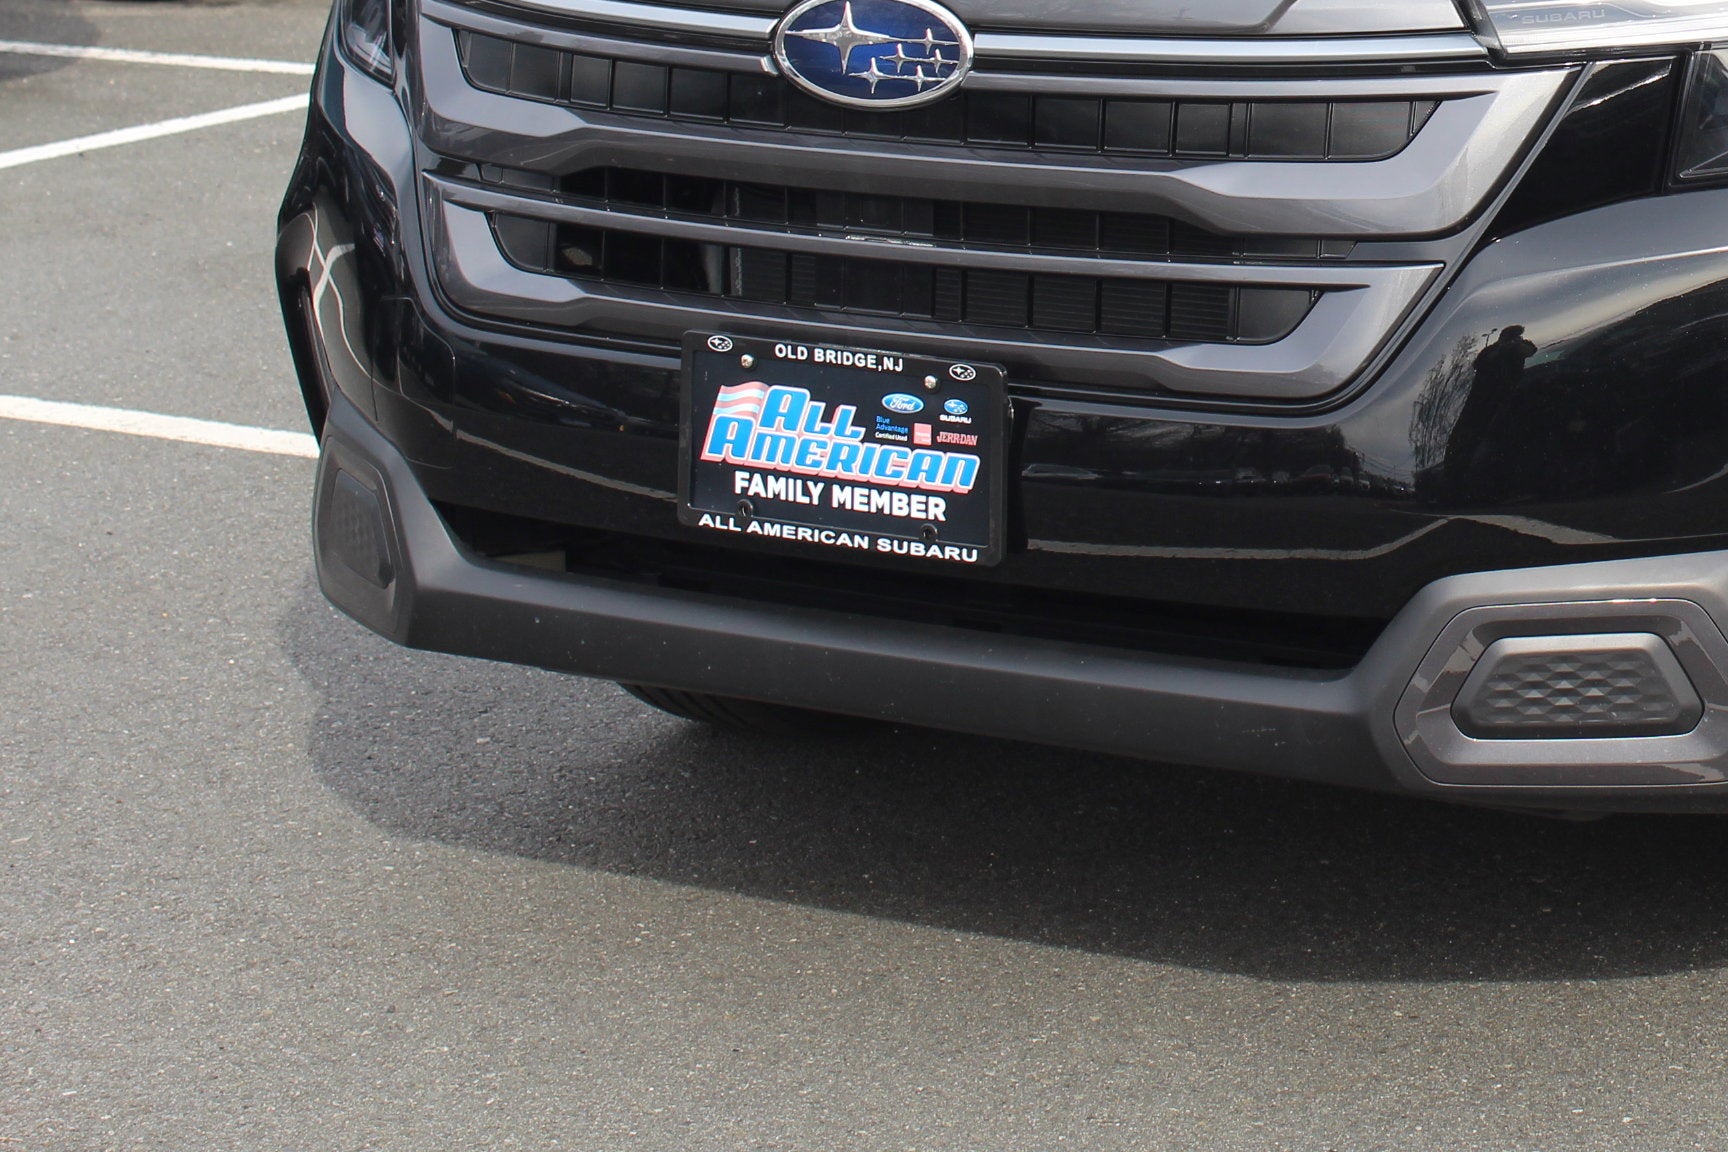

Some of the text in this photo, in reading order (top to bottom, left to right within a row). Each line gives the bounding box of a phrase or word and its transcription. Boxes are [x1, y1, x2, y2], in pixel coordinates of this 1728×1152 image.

[1522, 9, 1605, 24] SUBARU
[774, 343, 808, 360] OLD
[890, 397, 914, 410] Ford
[757, 385, 866, 440] ALL
[876, 416, 890, 424] Blue
[939, 414, 972, 424] SUBARU
[876, 424, 908, 434] Advantage
[701, 414, 981, 493] AMERICAN
[734, 471, 946, 521] FAMILY MEMBER
[698, 514, 978, 562] ALL AMERICAN SUBARU
